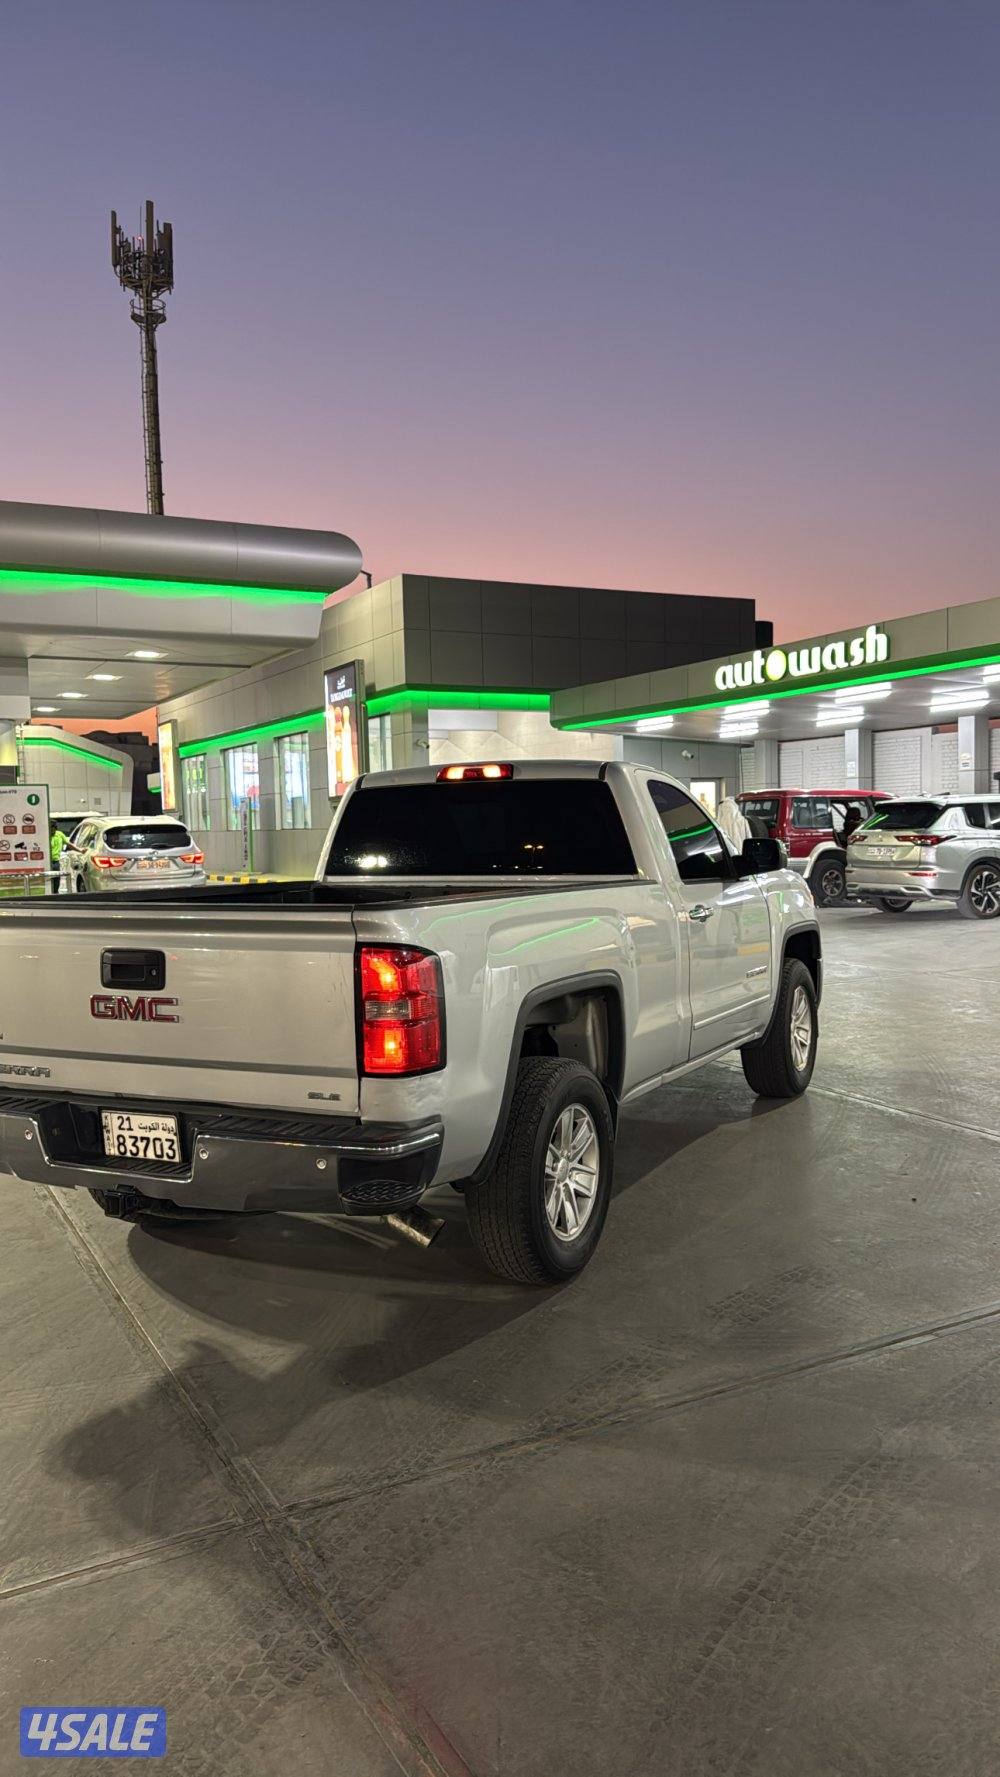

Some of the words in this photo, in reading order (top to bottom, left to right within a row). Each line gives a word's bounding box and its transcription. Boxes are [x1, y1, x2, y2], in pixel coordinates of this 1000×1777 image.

[714, 625, 888, 690] autowash
[90, 994, 180, 1023] GMC
[117, 1115, 134, 1131] 21
[116, 1134, 176, 1160] 83703
